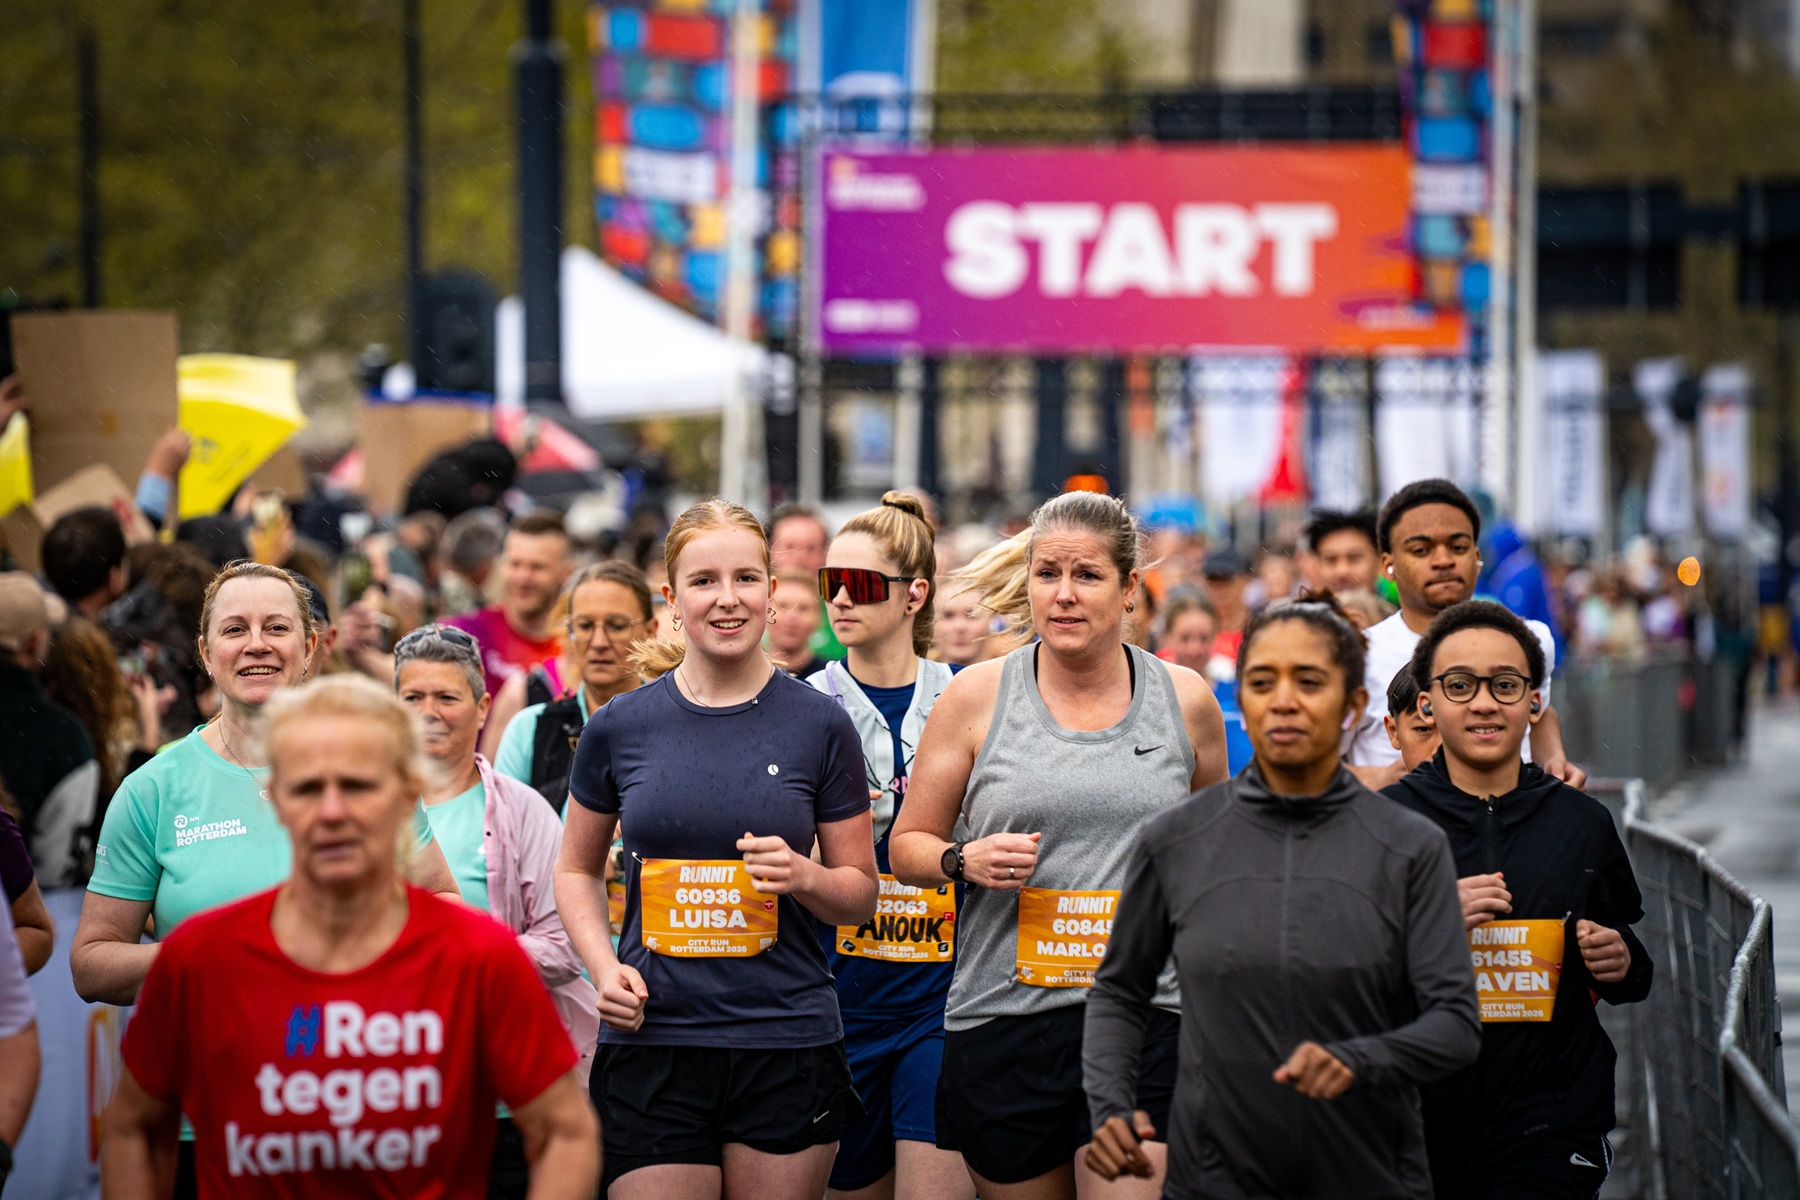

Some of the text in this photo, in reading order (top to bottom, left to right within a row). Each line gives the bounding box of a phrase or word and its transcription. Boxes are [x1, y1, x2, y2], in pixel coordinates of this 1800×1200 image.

[944, 201, 1337, 296] START
[175, 819, 240, 838] MARATHON
[176, 826, 246, 846] ROTTERDAM
[680, 866, 736, 883] RUNNIT
[676, 888, 741, 904] 60936
[1057, 896, 1114, 914] RUNNIT
[670, 909, 747, 928] LUISA
[856, 916, 945, 942] ANOUK
[1471, 927, 1529, 945] RUNNIT
[1037, 941, 1106, 957] MARLO
[1471, 950, 1532, 967] 61455
[1476, 972, 1550, 991] AVEN
[286, 1000, 444, 1058] #Ren
[256, 1063, 442, 1127] tegen
[225, 1120, 442, 1177] kanker
